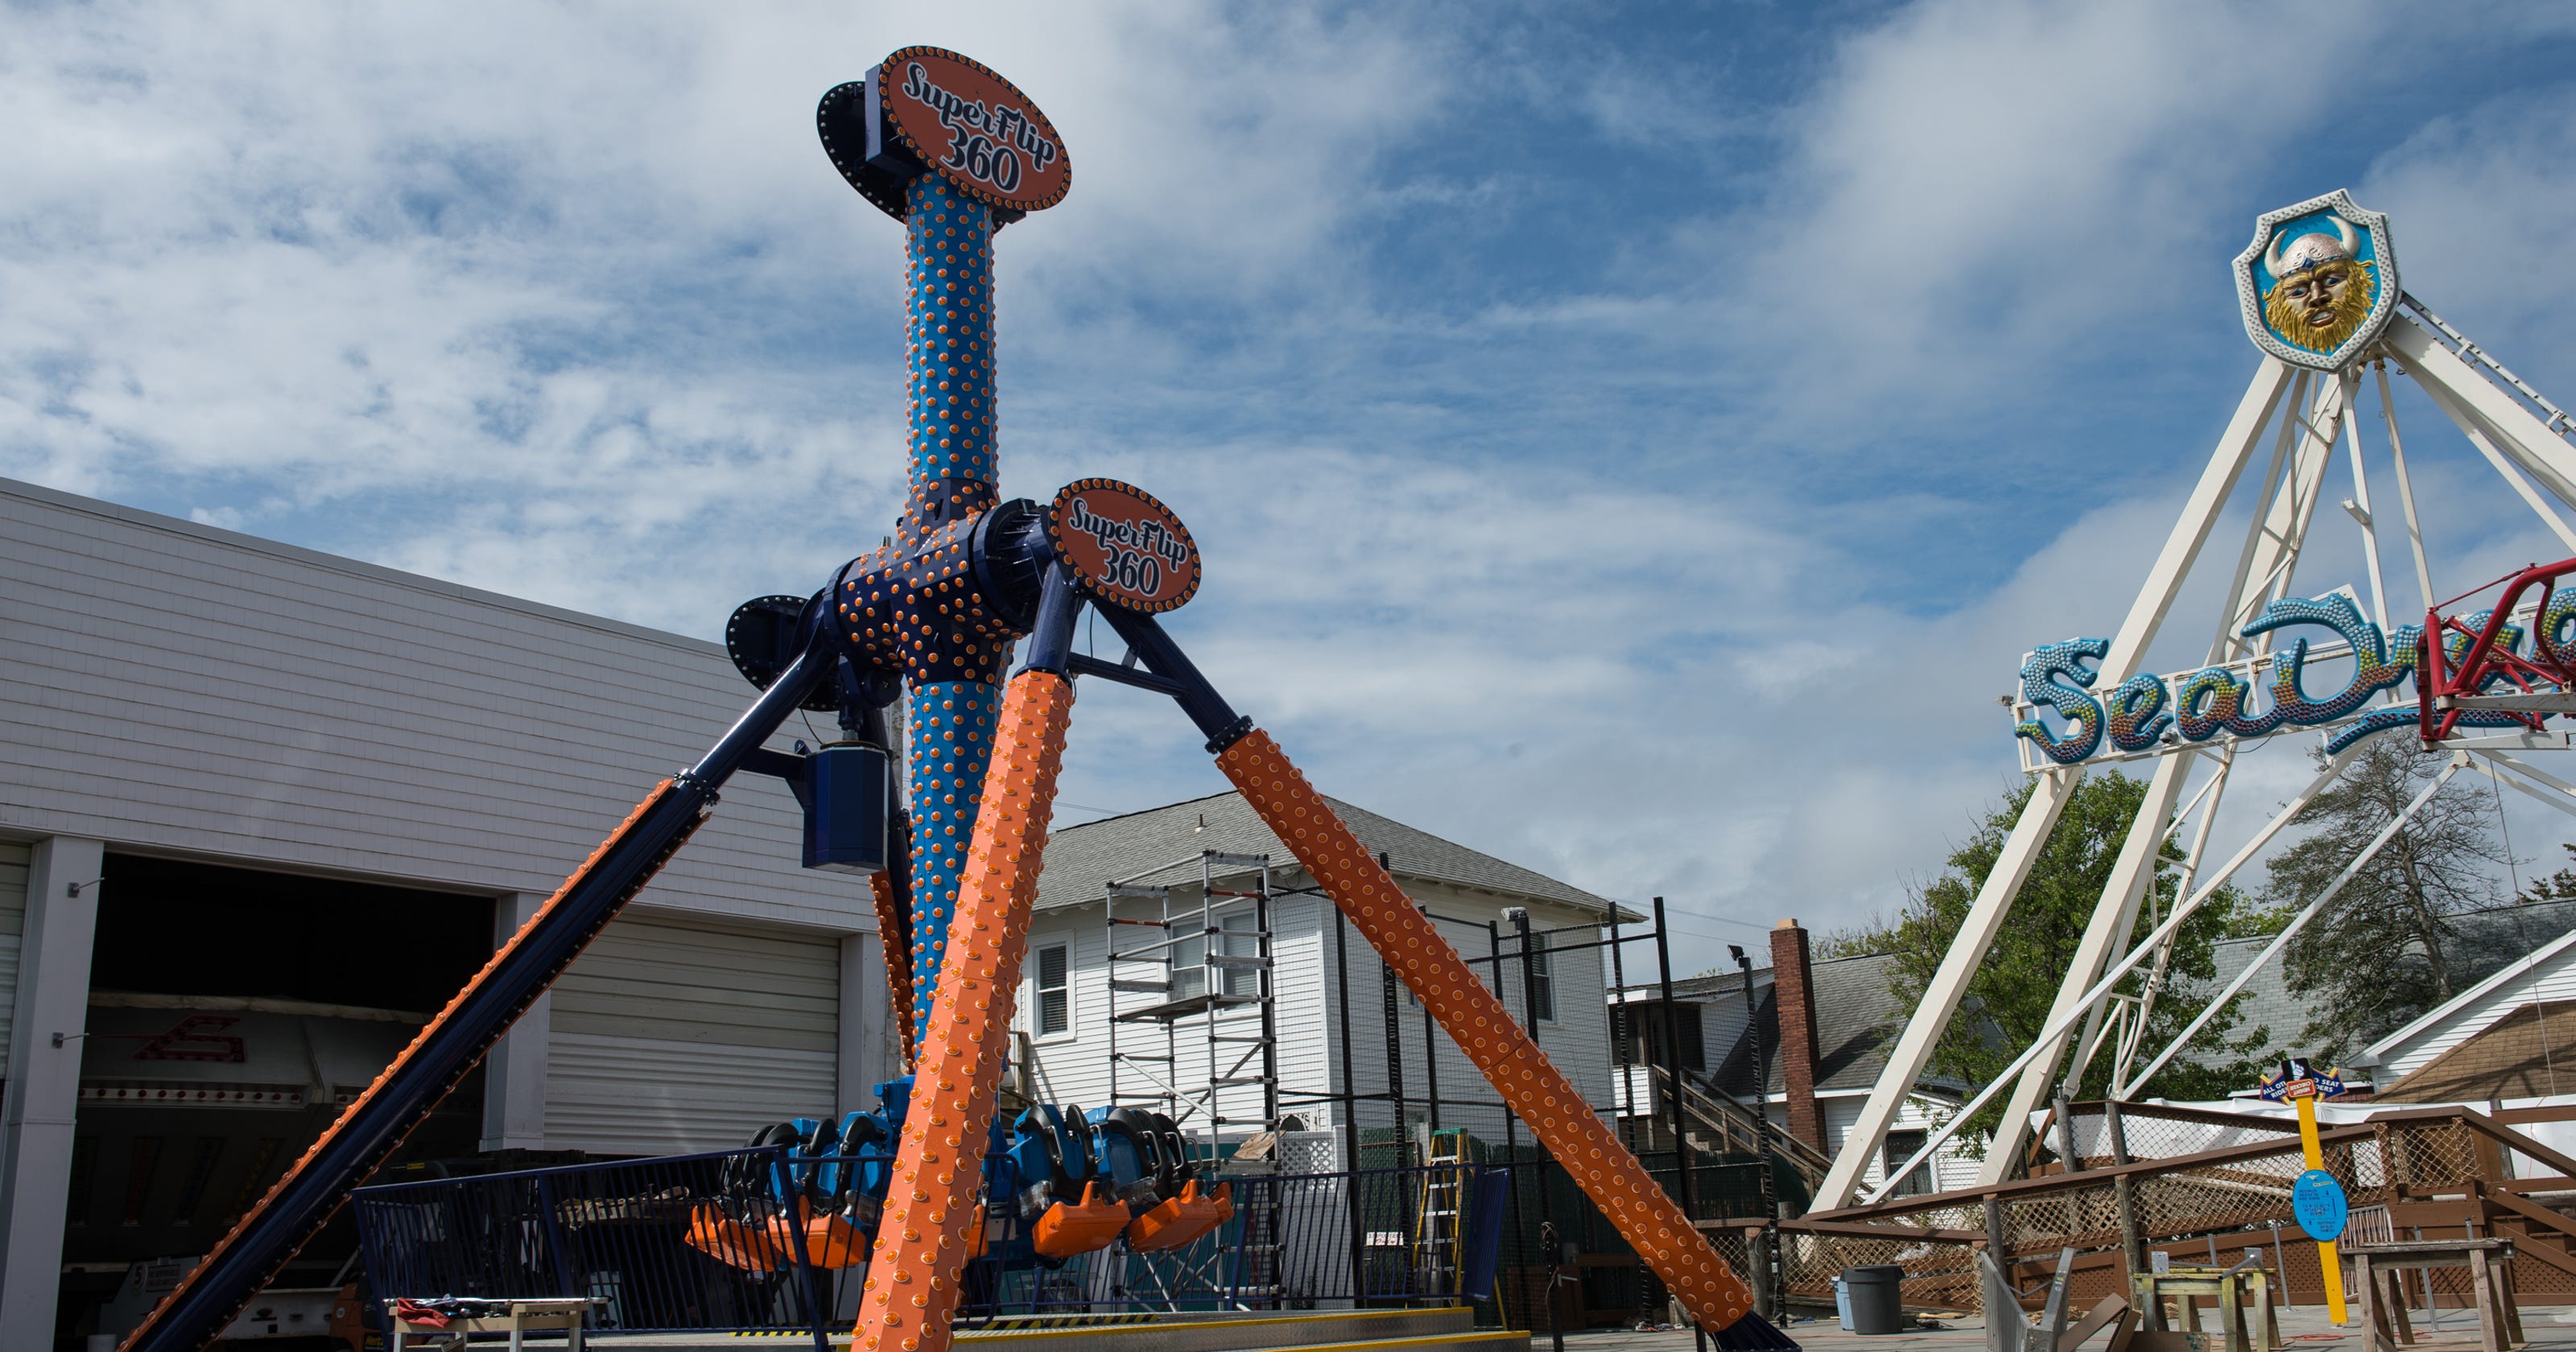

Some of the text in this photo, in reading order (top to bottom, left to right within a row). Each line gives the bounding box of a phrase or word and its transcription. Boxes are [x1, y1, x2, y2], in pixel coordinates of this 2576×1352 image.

[940, 121, 1022, 194] 360
[1097, 542, 1161, 597] 360
[2315, 1084, 2334, 1093] DERS
[2322, 1078, 2340, 1088] SEAT
[2263, 1086, 2275, 1095] ALL
[134, 1266, 142, 1284] 5
